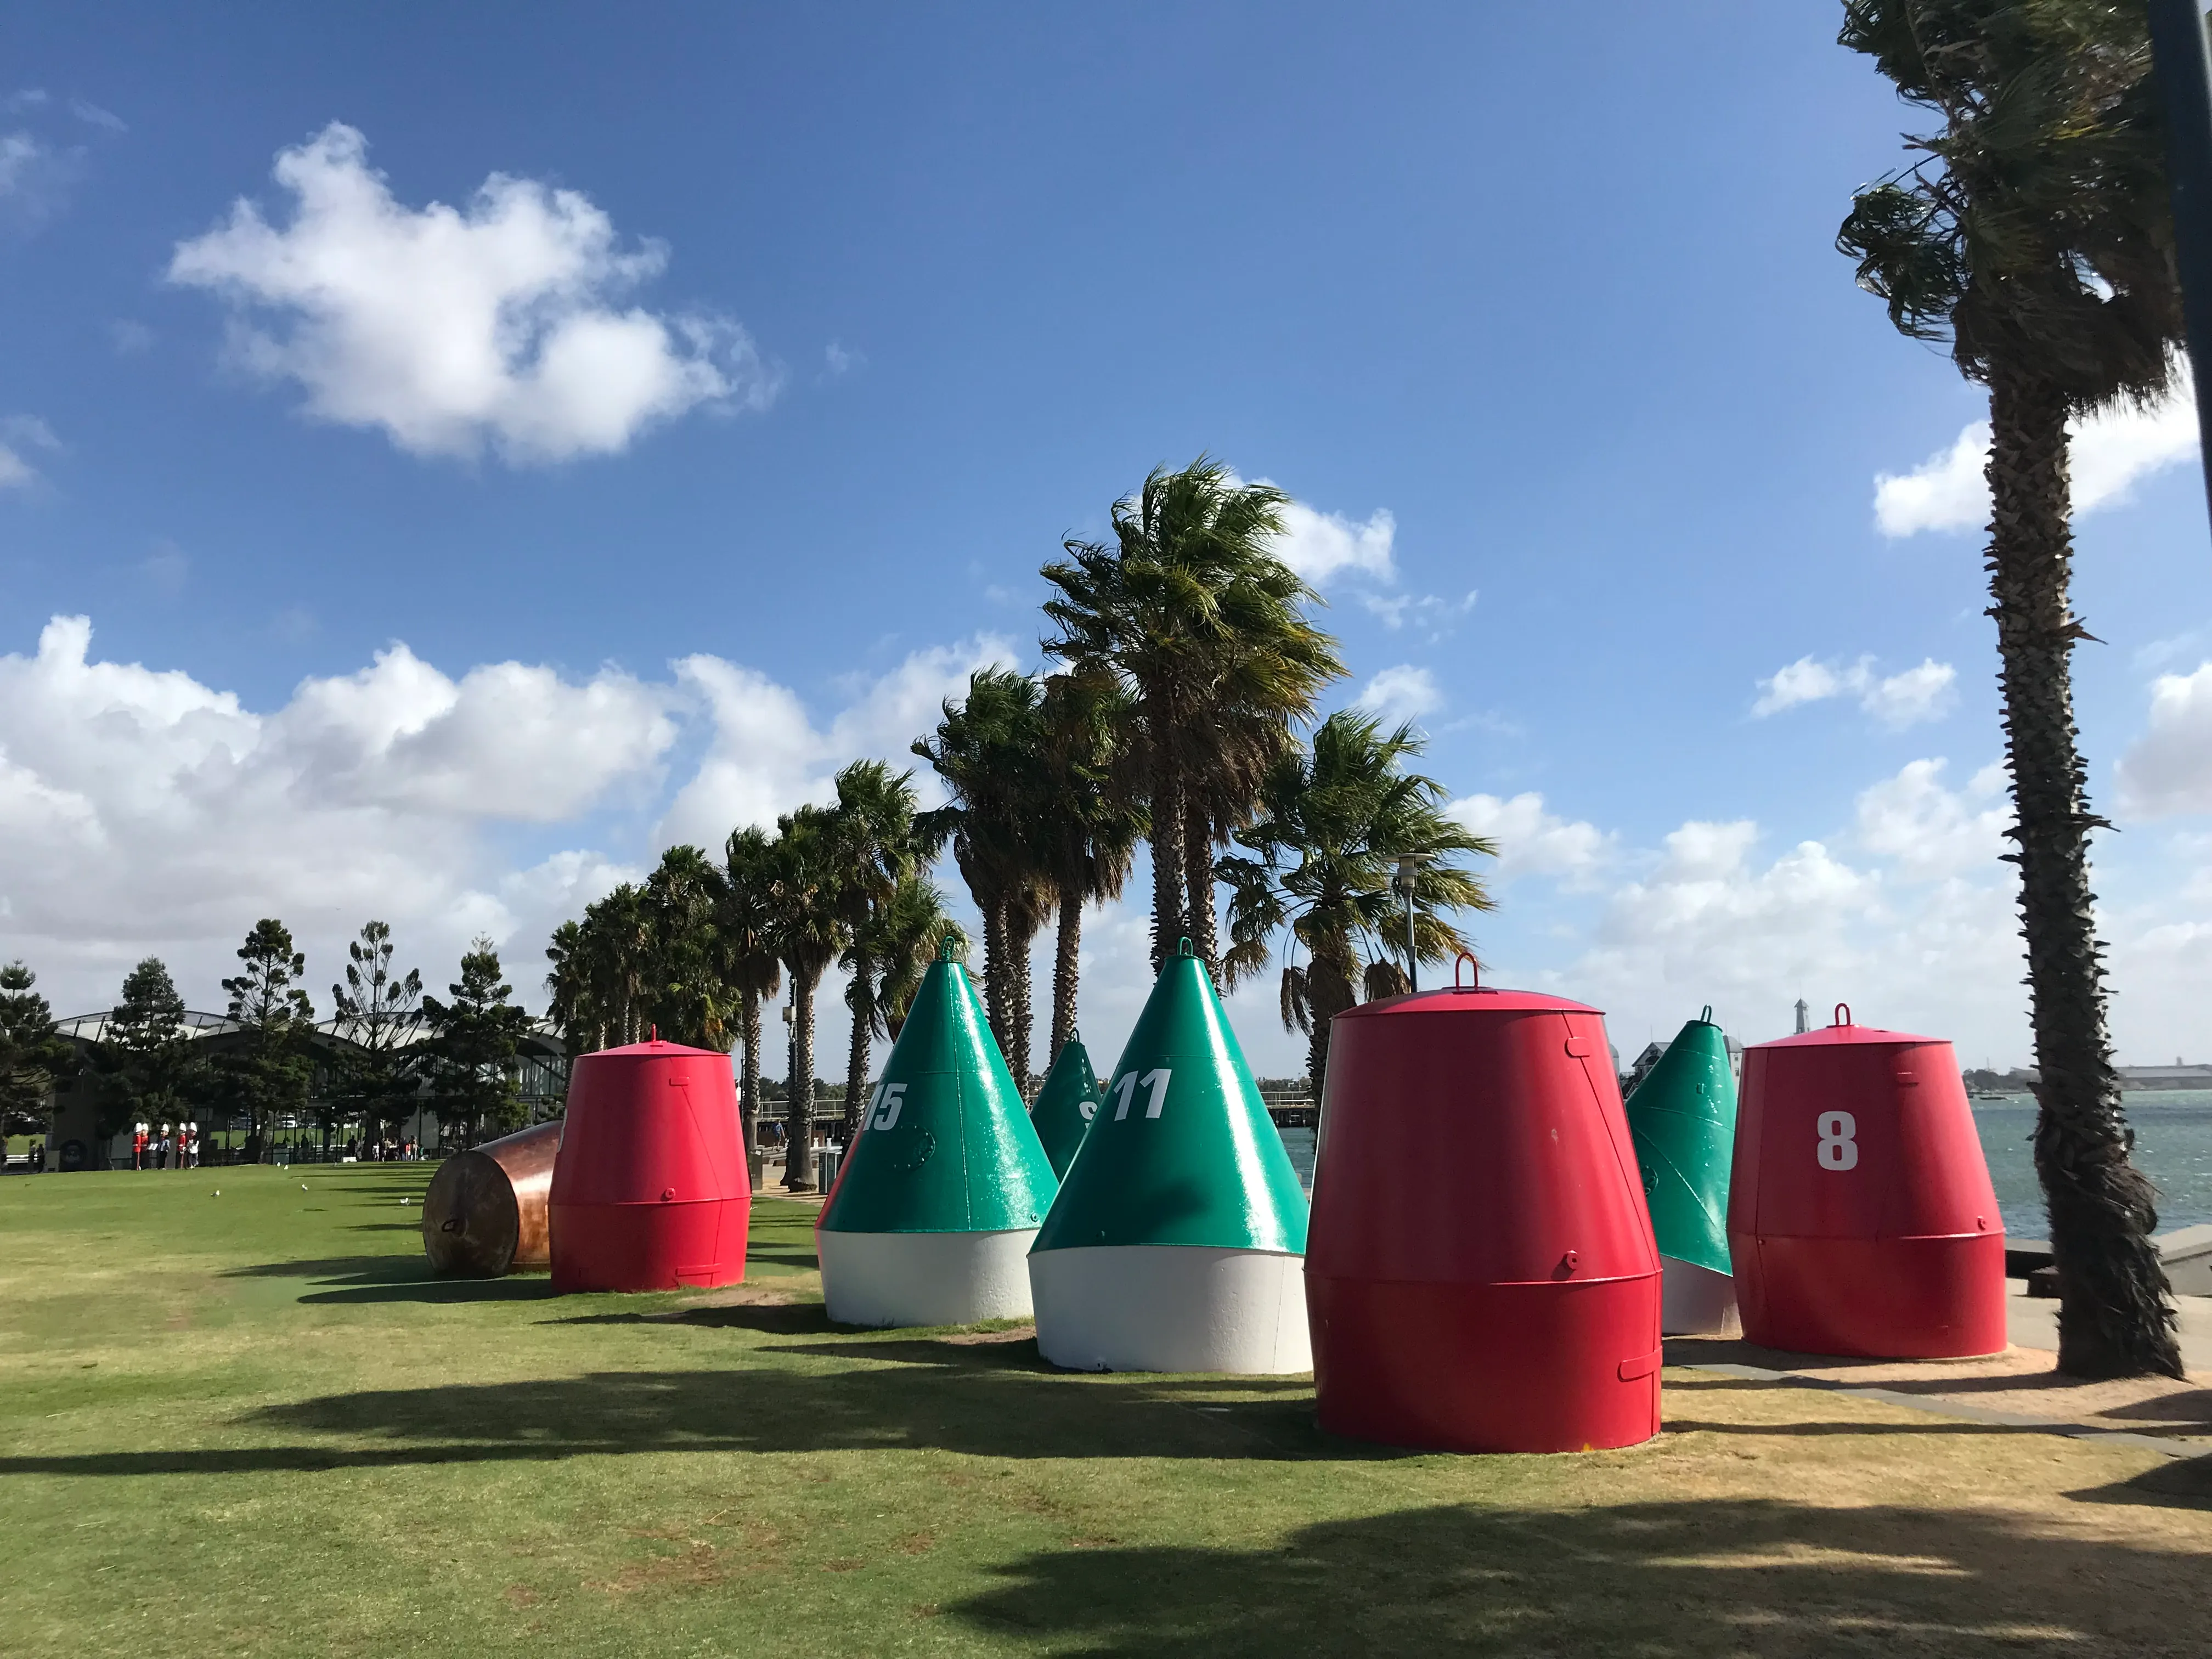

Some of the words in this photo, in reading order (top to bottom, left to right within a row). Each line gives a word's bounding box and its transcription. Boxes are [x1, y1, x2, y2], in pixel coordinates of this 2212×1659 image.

[863, 1083, 908, 1131] 15
[1113, 1068, 1172, 1121] 11
[1817, 1110, 1859, 1171] 8
